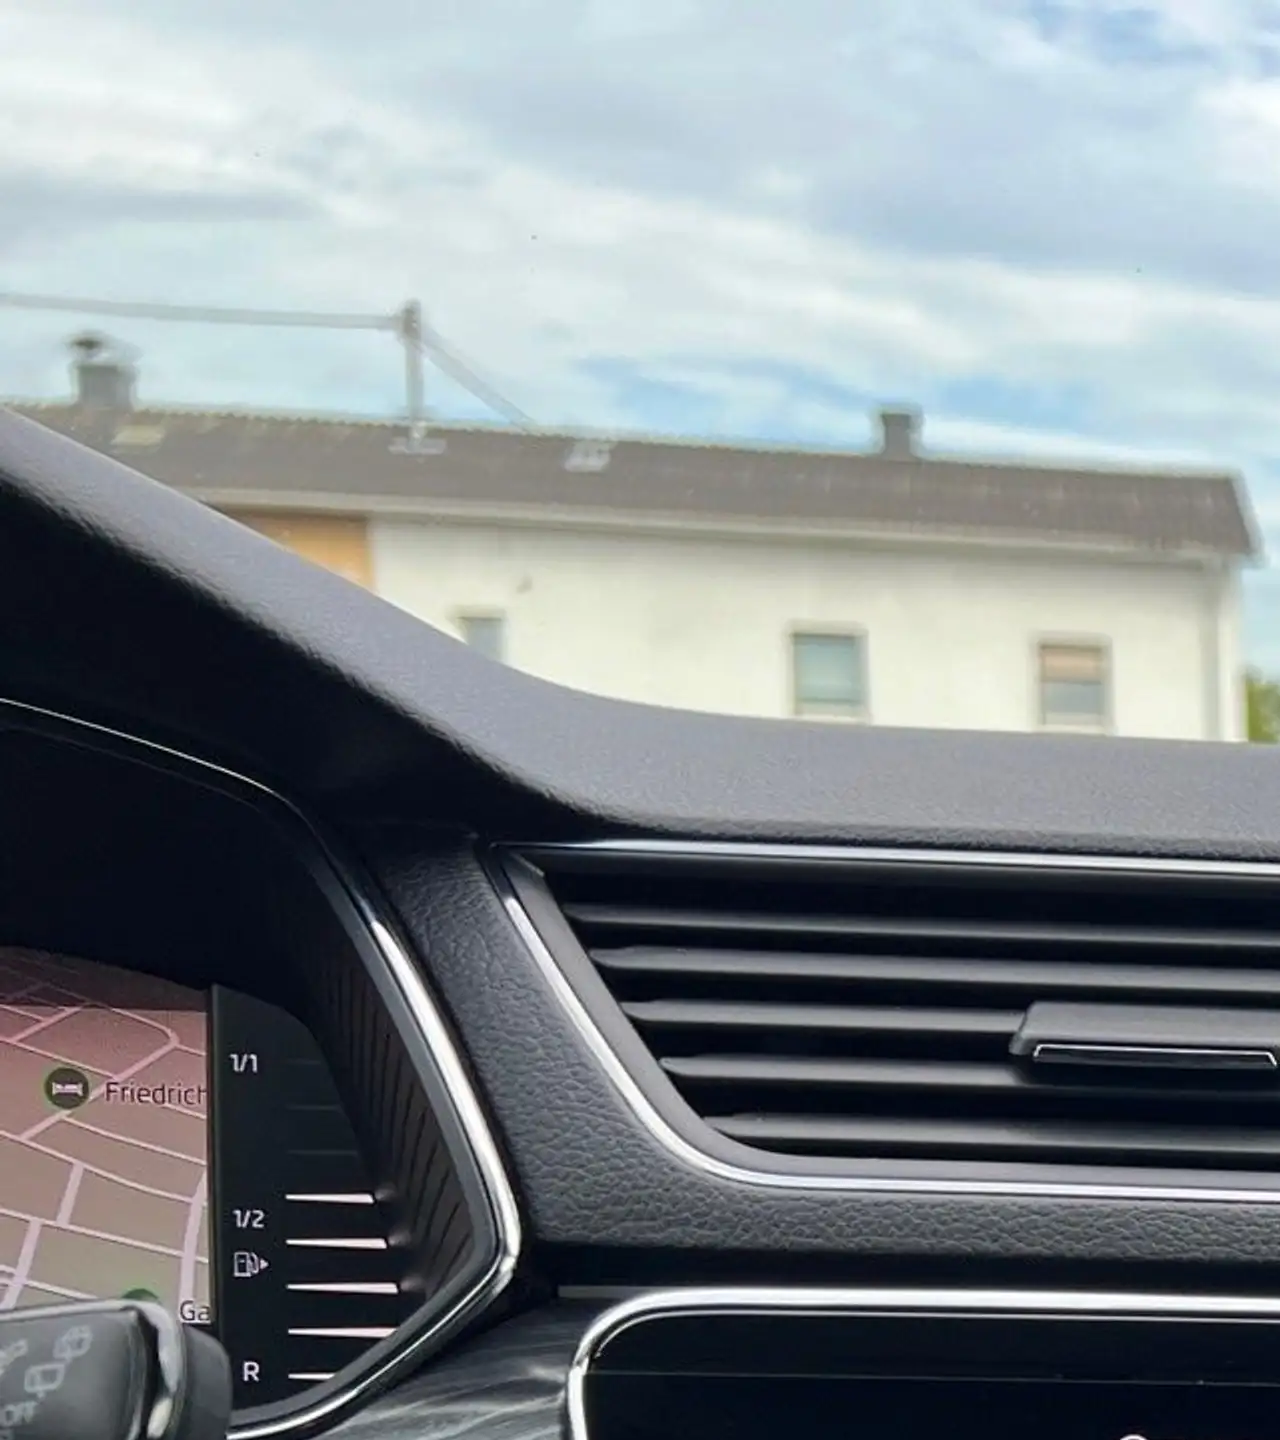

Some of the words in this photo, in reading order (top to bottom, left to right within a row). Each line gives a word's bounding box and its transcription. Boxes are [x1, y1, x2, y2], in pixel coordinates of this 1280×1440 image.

[229, 1053, 258, 1073] 1/1
[104, 1080, 208, 1105] Friedrich
[233, 1209, 265, 1229] 1/2
[180, 1300, 211, 1322] Ga
[243, 1361, 260, 1382] R
